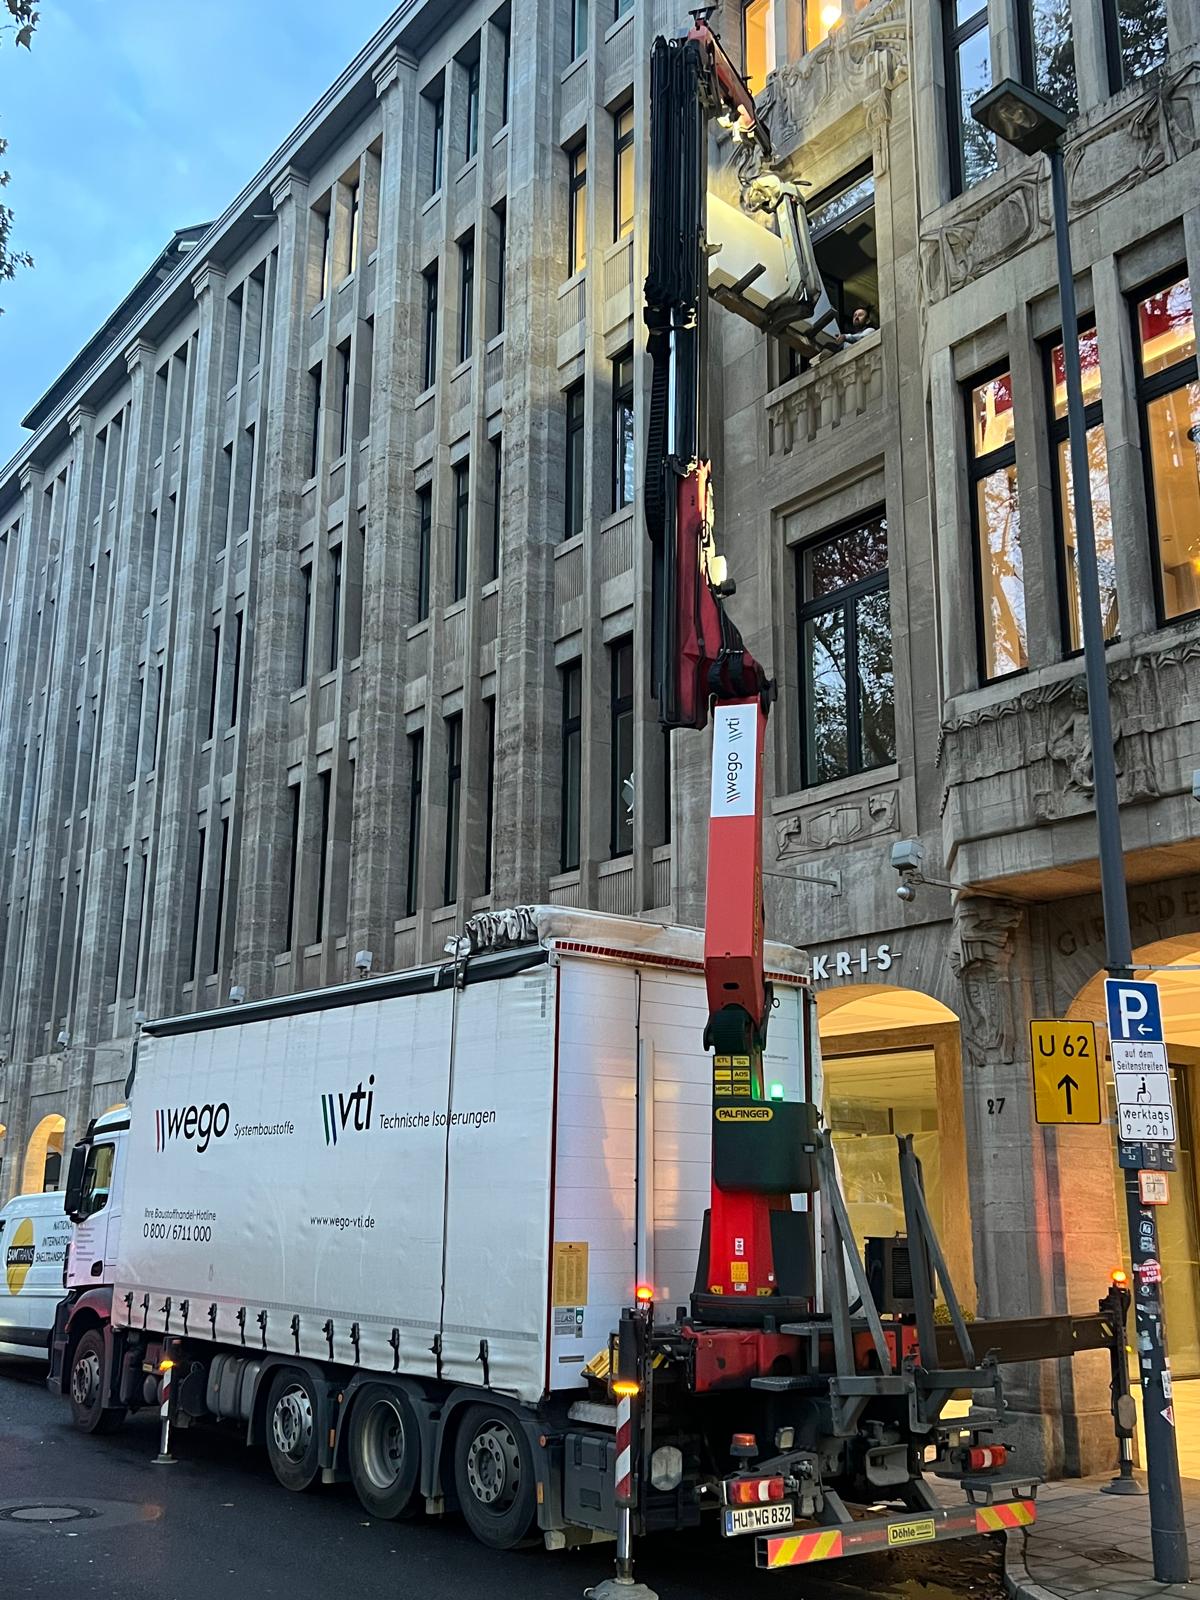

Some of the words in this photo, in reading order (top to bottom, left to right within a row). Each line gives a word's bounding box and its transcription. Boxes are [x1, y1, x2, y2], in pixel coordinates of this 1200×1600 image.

[725, 717, 740, 734] vti
[727, 752, 743, 794] wego
[812, 944, 892, 980] KRIS
[1118, 988, 1148, 1038] P
[1038, 1034, 1056, 1057] U
[1063, 1034, 1090, 1057] 62
[1125, 1049, 1136, 1058] auf
[1139, 1050, 1154, 1059] dem
[1117, 1060, 1164, 1071] Seitenstreifen
[338, 1074, 375, 1131] vti
[379, 1112, 429, 1129] Technische
[432, 1109, 496, 1128] Isolierungen
[987, 1097, 1006, 1115] 27
[719, 1109, 769, 1119] PALFINGER
[167, 1102, 230, 1153] wego
[234, 1120, 295, 1140] Systembaustoffe
[1126, 1124, 1132, 1135] 9
[1146, 1125, 1158, 1136] 20
[1162, 1126, 1169, 1136] h
[144, 1207, 154, 1218] Ihre
[154, 1207, 217, 1221] Baustoffhandel-Hotline
[310, 1215, 375, 1231] www.wego-vti.de
[143, 1222, 149, 1238] 0
[150, 1223, 166, 1239] 800
[172, 1224, 191, 1241] 6711
[193, 1225, 212, 1242] 000
[733, 1511, 748, 1529] HU
[754, 1509, 769, 1526] WG
[771, 1506, 791, 1524] 832
[892, 1527, 915, 1540] Döhle
